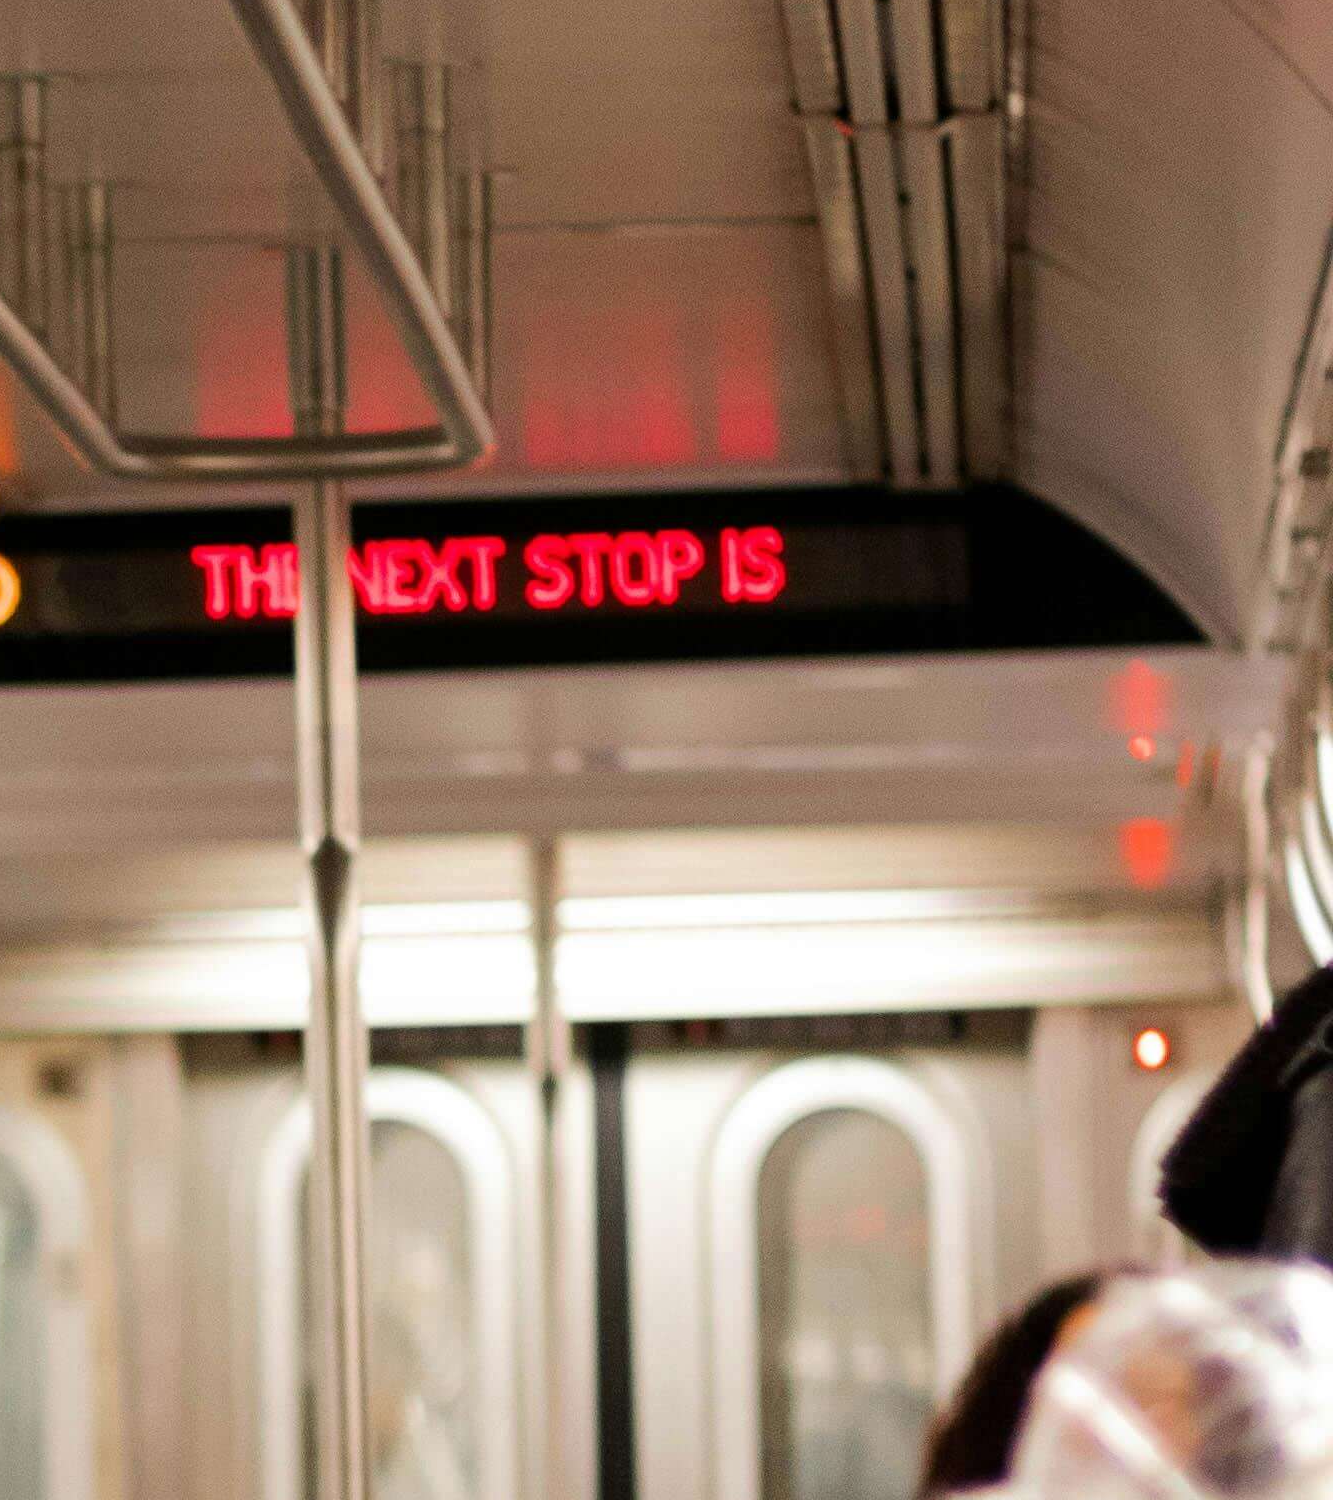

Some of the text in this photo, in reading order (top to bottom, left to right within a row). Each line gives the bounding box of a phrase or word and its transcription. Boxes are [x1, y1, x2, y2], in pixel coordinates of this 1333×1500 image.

[343, 537, 506, 614] NEXT
[524, 531, 704, 608] STOP
[720, 527, 785, 603] IS
